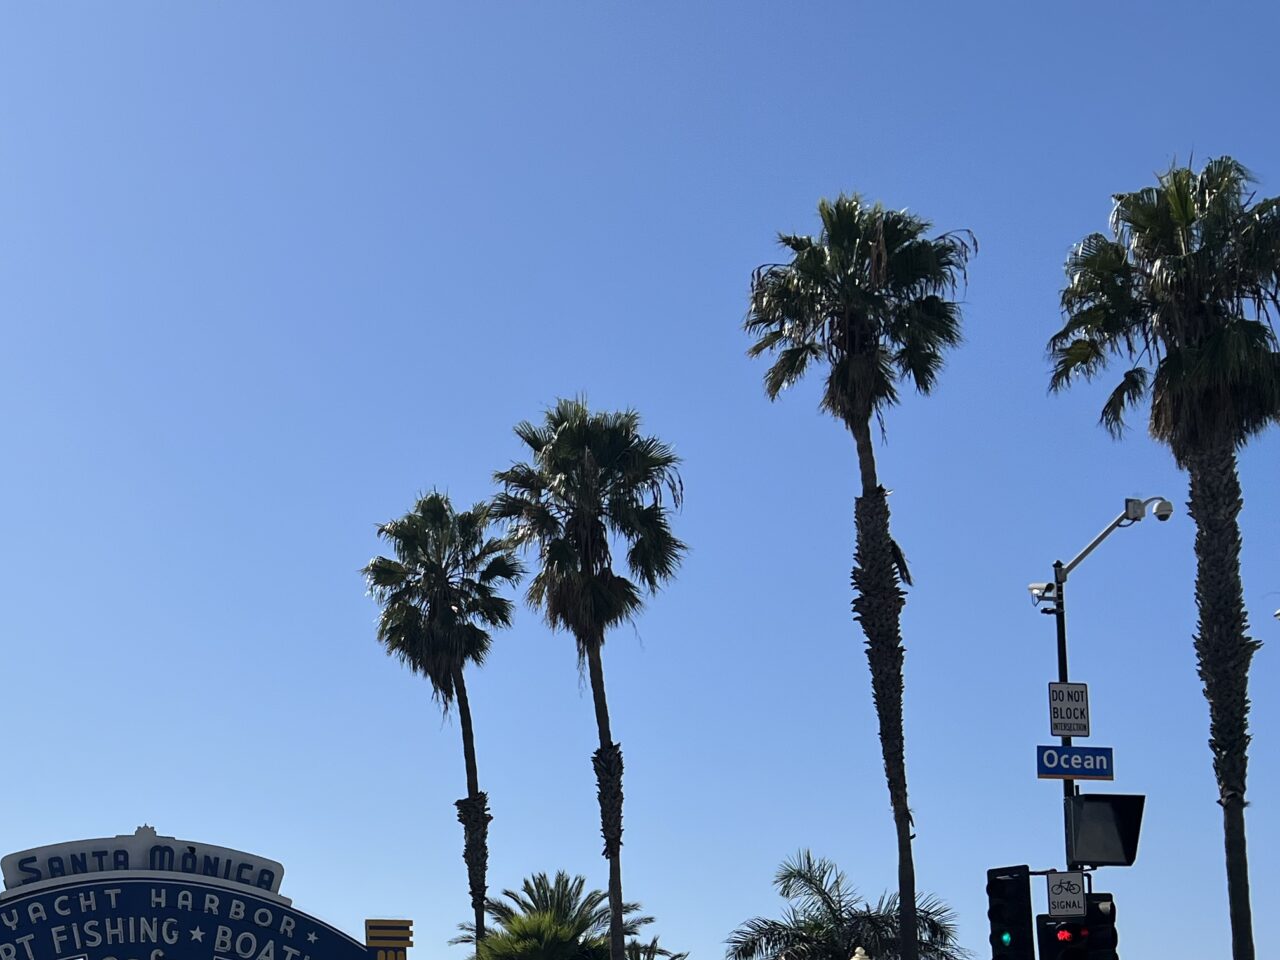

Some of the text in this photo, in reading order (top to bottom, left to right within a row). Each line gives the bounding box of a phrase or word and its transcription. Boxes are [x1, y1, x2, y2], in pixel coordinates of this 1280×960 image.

[1051, 690, 1084, 703] DO NOT
[1053, 707, 1086, 720] BLOCK
[1053, 722, 1087, 732] INTERSECTION
[1043, 749, 1107, 770] Ocean
[17, 845, 276, 891] SANTA MONICA
[0, 888, 297, 938] YACHT HARBOR
[1051, 900, 1083, 910] SIGNAL
[50, 916, 180, 954] FISHING
